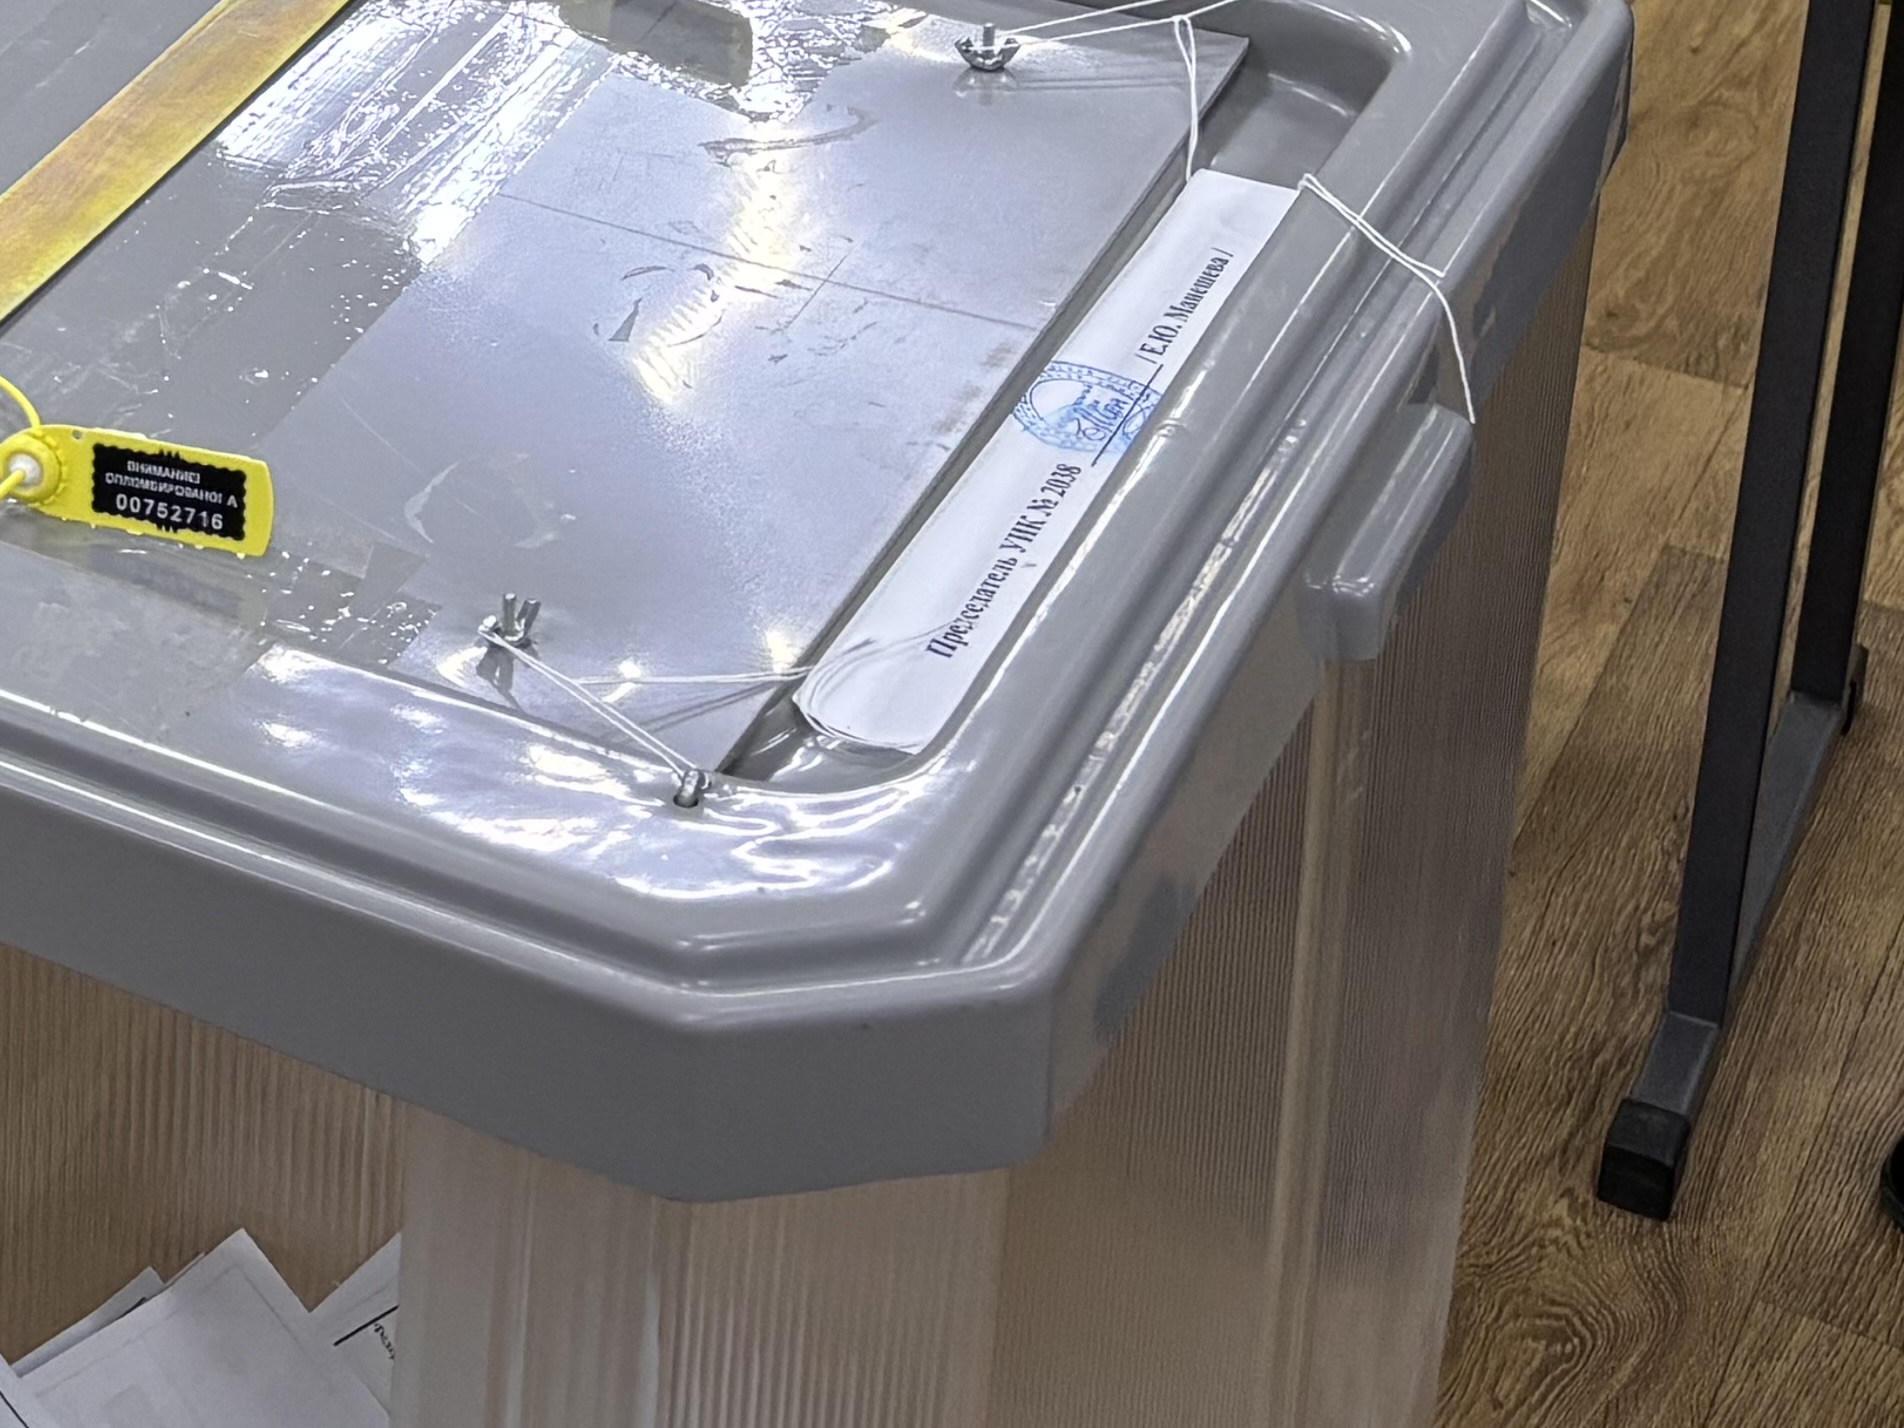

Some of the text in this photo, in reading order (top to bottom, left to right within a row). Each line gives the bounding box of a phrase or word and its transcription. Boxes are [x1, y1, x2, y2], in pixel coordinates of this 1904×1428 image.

[1162, 256, 1229, 322] Манешева
[1138, 324, 1182, 355] Е.Ю.
[1040, 463, 1081, 498] 2038
[115, 493, 224, 531] 00752716
[1026, 498, 1058, 517] №
[998, 514, 1046, 553] УИК
[924, 558, 1017, 658] Председатель
